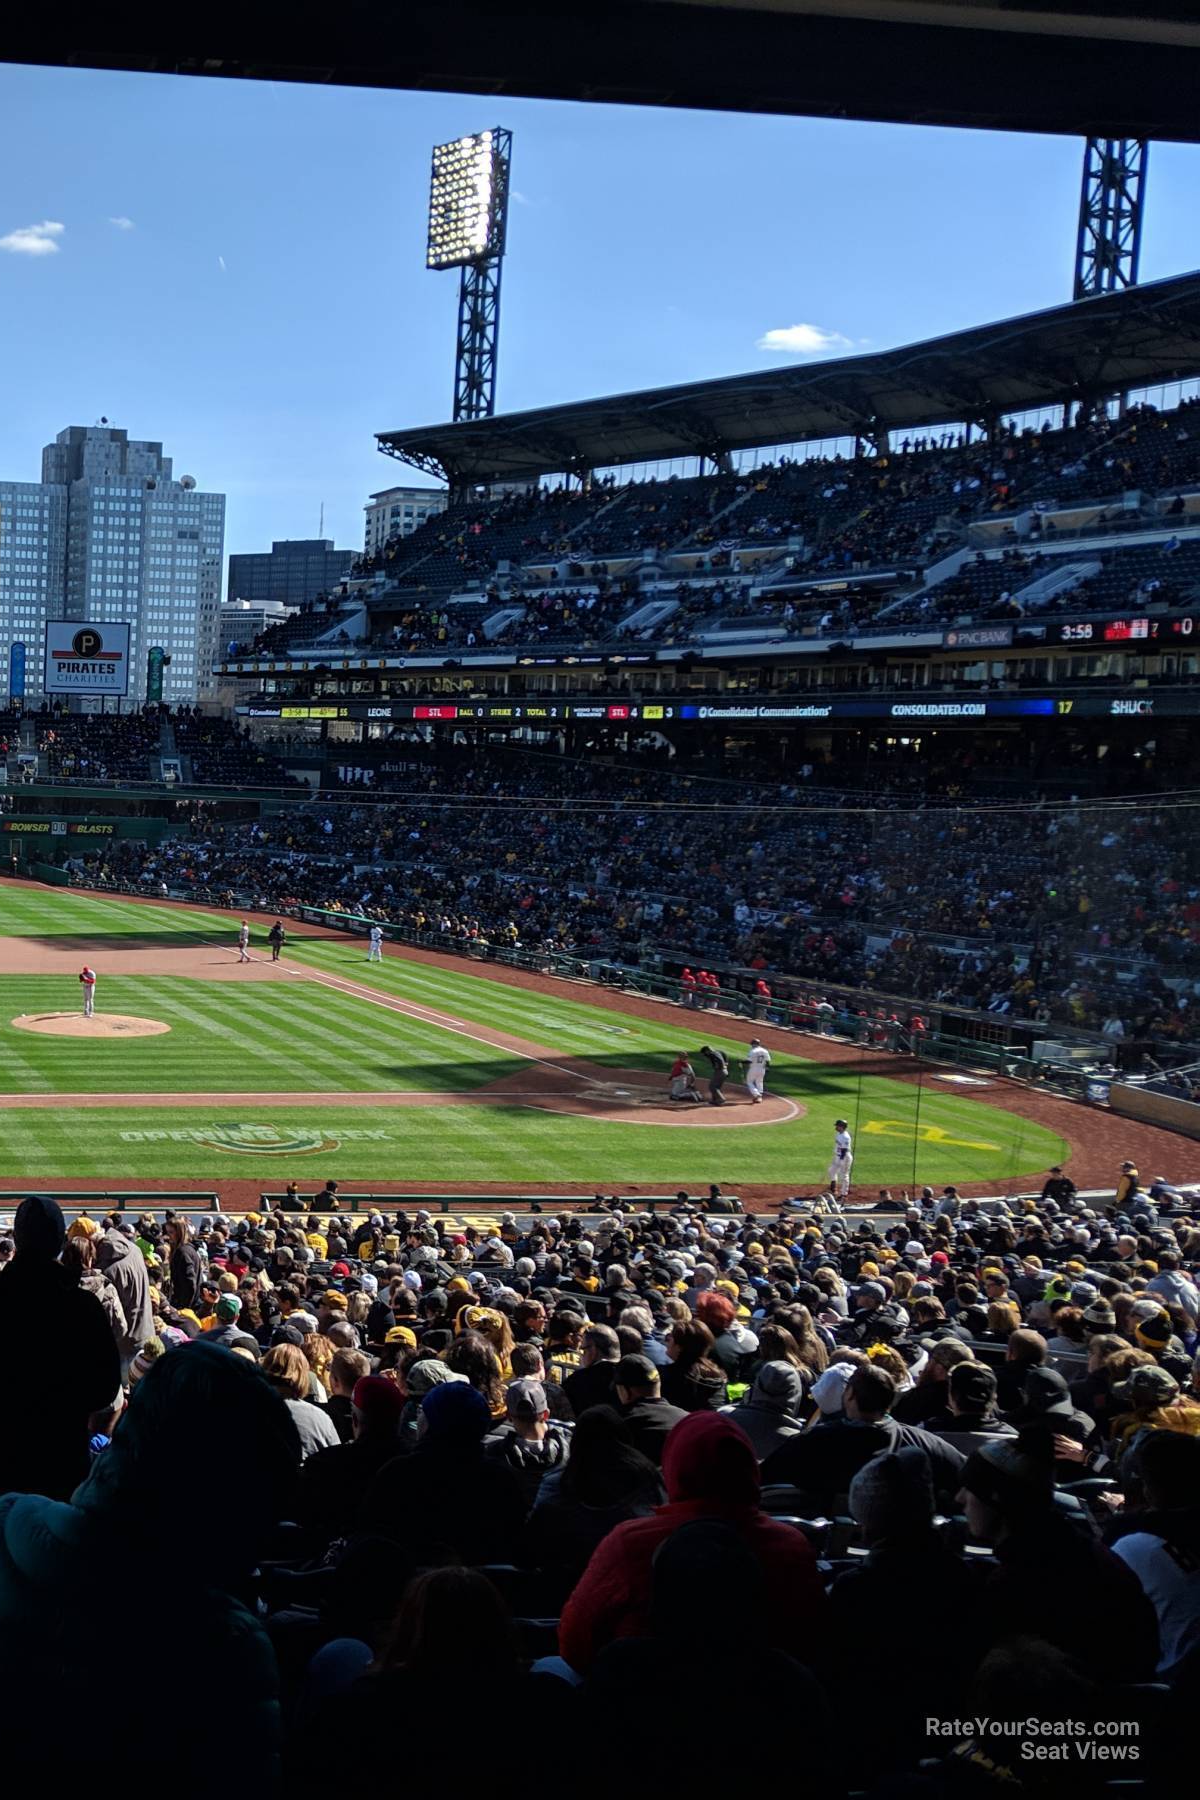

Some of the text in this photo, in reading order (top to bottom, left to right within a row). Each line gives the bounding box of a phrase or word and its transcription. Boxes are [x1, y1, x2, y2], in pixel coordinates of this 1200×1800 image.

[1061, 624, 1092, 640] 3:58
[81, 635, 95, 653] P
[57, 662, 116, 674] PIRATES
[56, 674, 116, 683] CHARITIES
[367, 708, 392, 717] LEONE
[429, 708, 442, 717] STL
[515, 707, 521, 717] 2
[527, 708, 547, 716] TOTAL
[551, 707, 557, 717] 2
[612, 707, 638, 717] STL 4
[666, 707, 673, 717] 3
[708, 706, 757, 717] Consolidated
[891, 704, 986, 716] CONSOLIDATED.COM
[1057, 701, 1073, 714] 17
[1110, 700, 1154, 714] SHUCK
[380, 762, 406, 772] skull
[338, 766, 375, 784] lite
[10, 822, 49, 832] BOWSER
[77, 825, 113, 834] BLASTS
[119, 1129, 396, 1141] OPENING WEEK
